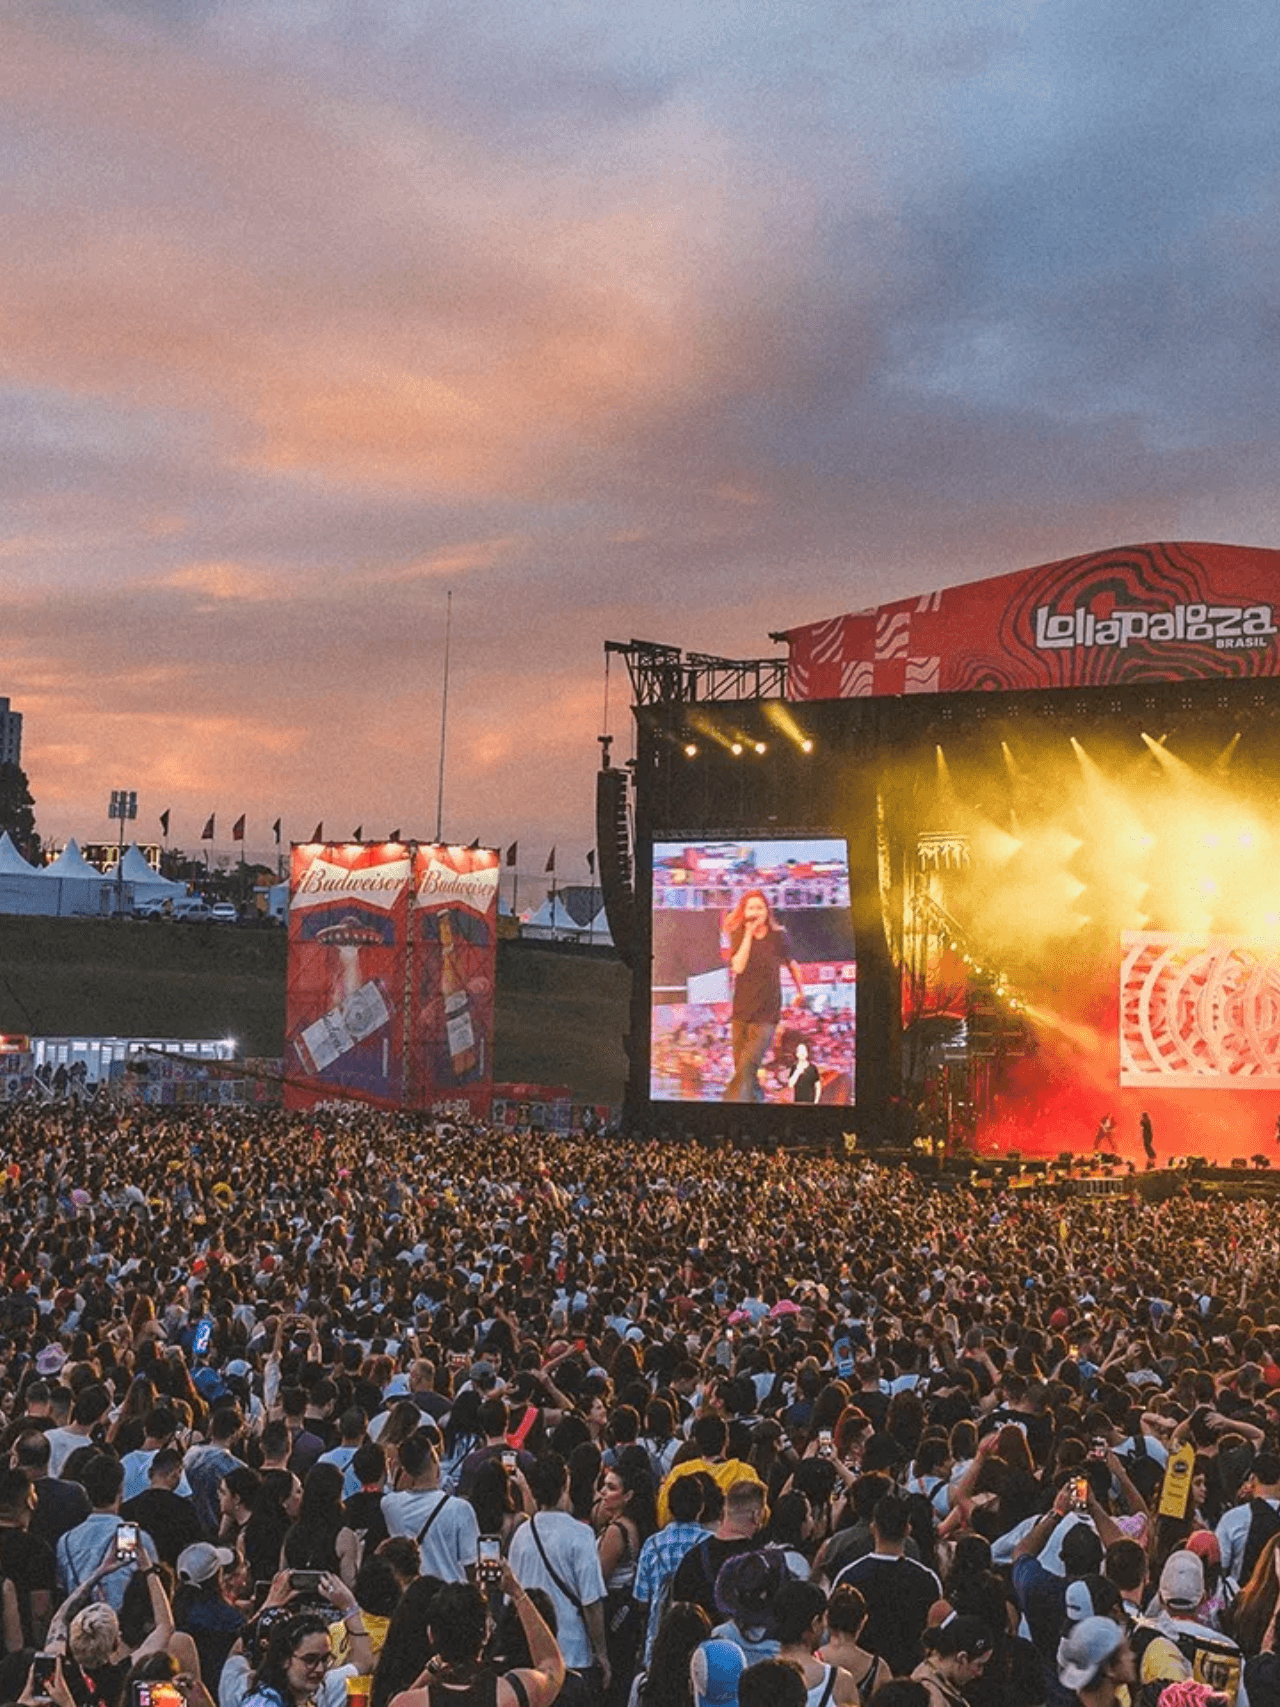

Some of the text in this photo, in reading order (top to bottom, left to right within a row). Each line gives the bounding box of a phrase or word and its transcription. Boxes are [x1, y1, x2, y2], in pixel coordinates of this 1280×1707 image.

[1036, 604, 1278, 649] Lollapalooza
[1216, 637, 1267, 649] BRASIL
[300, 868, 408, 894] Budweiser
[421, 870, 496, 895] Budweiser
